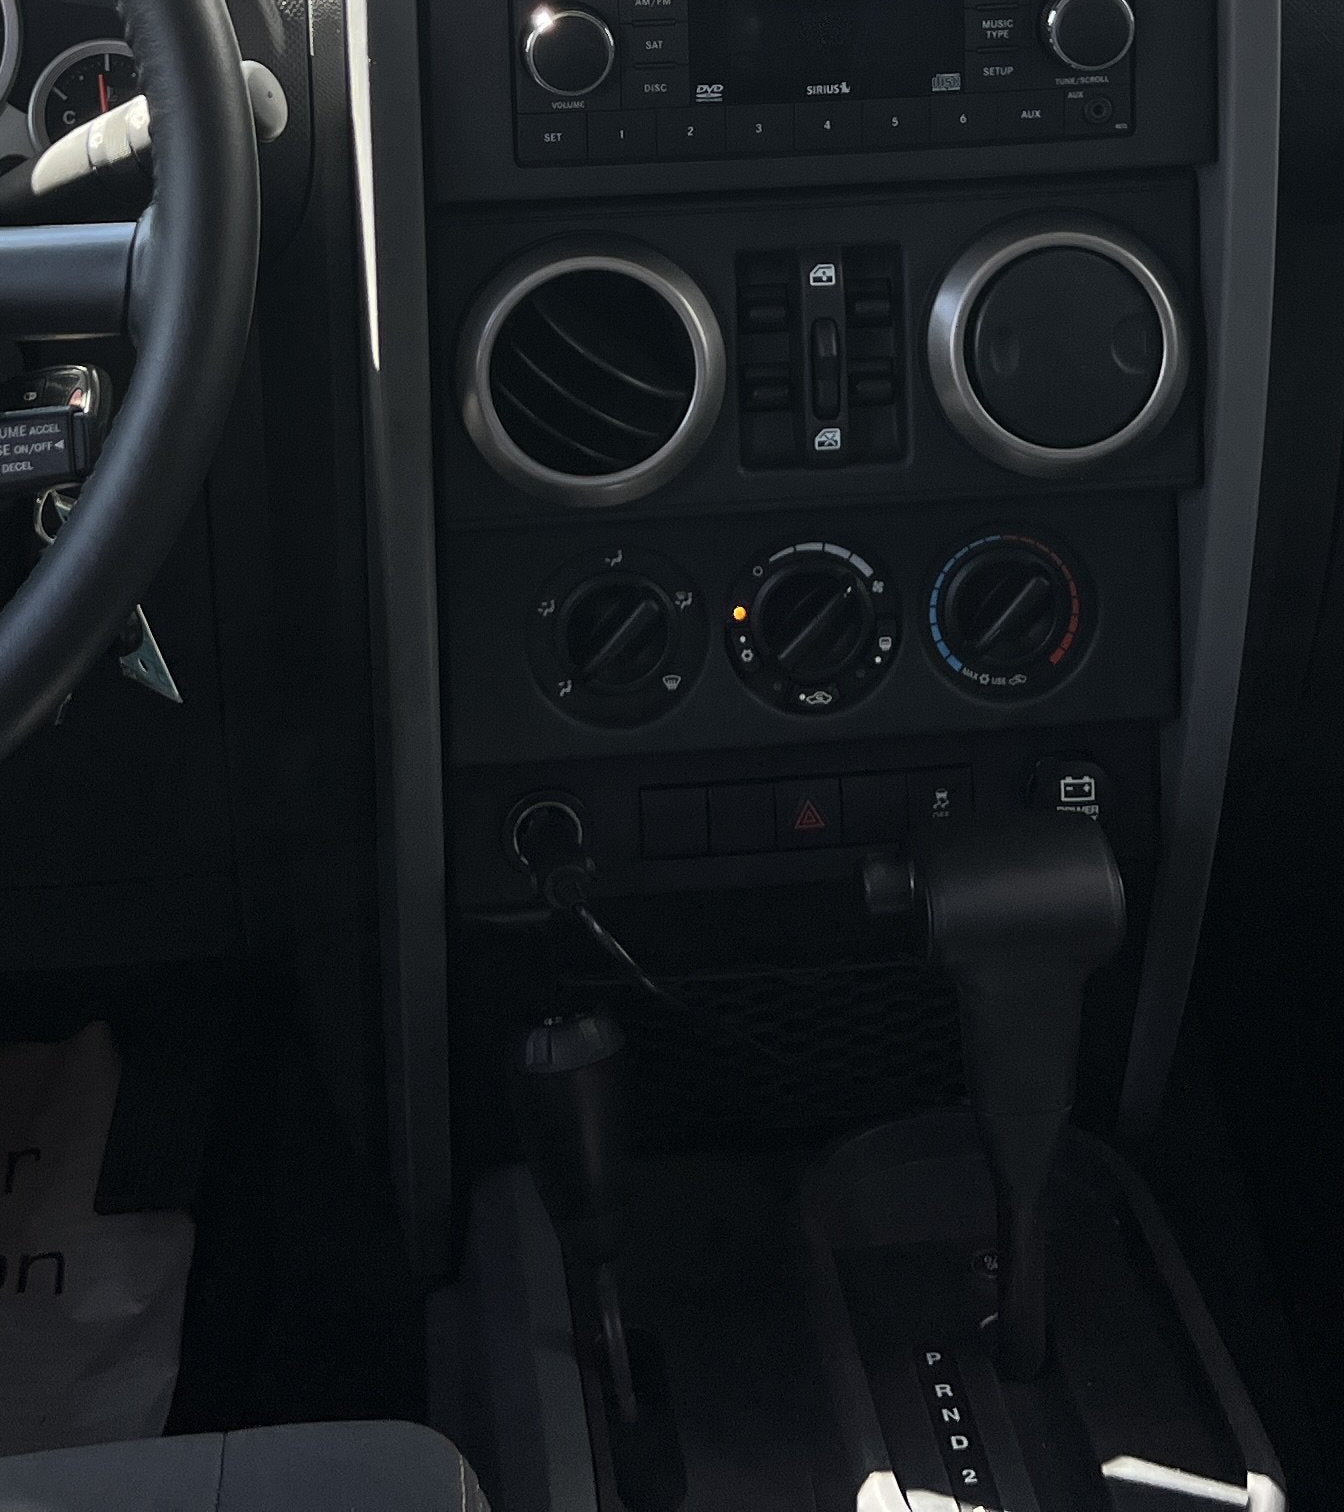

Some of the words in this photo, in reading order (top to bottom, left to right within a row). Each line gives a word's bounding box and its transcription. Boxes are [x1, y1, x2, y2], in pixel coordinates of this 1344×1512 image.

[982, 19, 1013, 29] MUSIC
[986, 29, 1009, 39] TYPE
[645, 40, 663, 50] SAT
[983, 66, 1013, 76] SETUP
[644, 83, 667, 93] DISC
[696, 84, 724, 97] DVD
[806, 84, 840, 96] SIRIUS
[552, 100, 585, 109] VOLUME
[62, 110, 76, 124] C
[544, 133, 562, 142] SET
[687, 126, 694, 136] 2
[755, 123, 763, 133] 3
[823, 120, 832, 130] 4
[891, 117, 899, 127] 5
[959, 114, 967, 124] 6
[1021, 109, 1041, 119] AUX
[28, 423, 61, 435] ACCEL
[14, 441, 52, 454] ON/OFF
[2, 461, 35, 474] DECEL
[925, 1352, 942, 1365] P
[934, 1384, 954, 1398] R
[941, 1407, 960, 1422] N
[950, 1435, 969, 1450] D
[961, 1469, 978, 1485] 2
